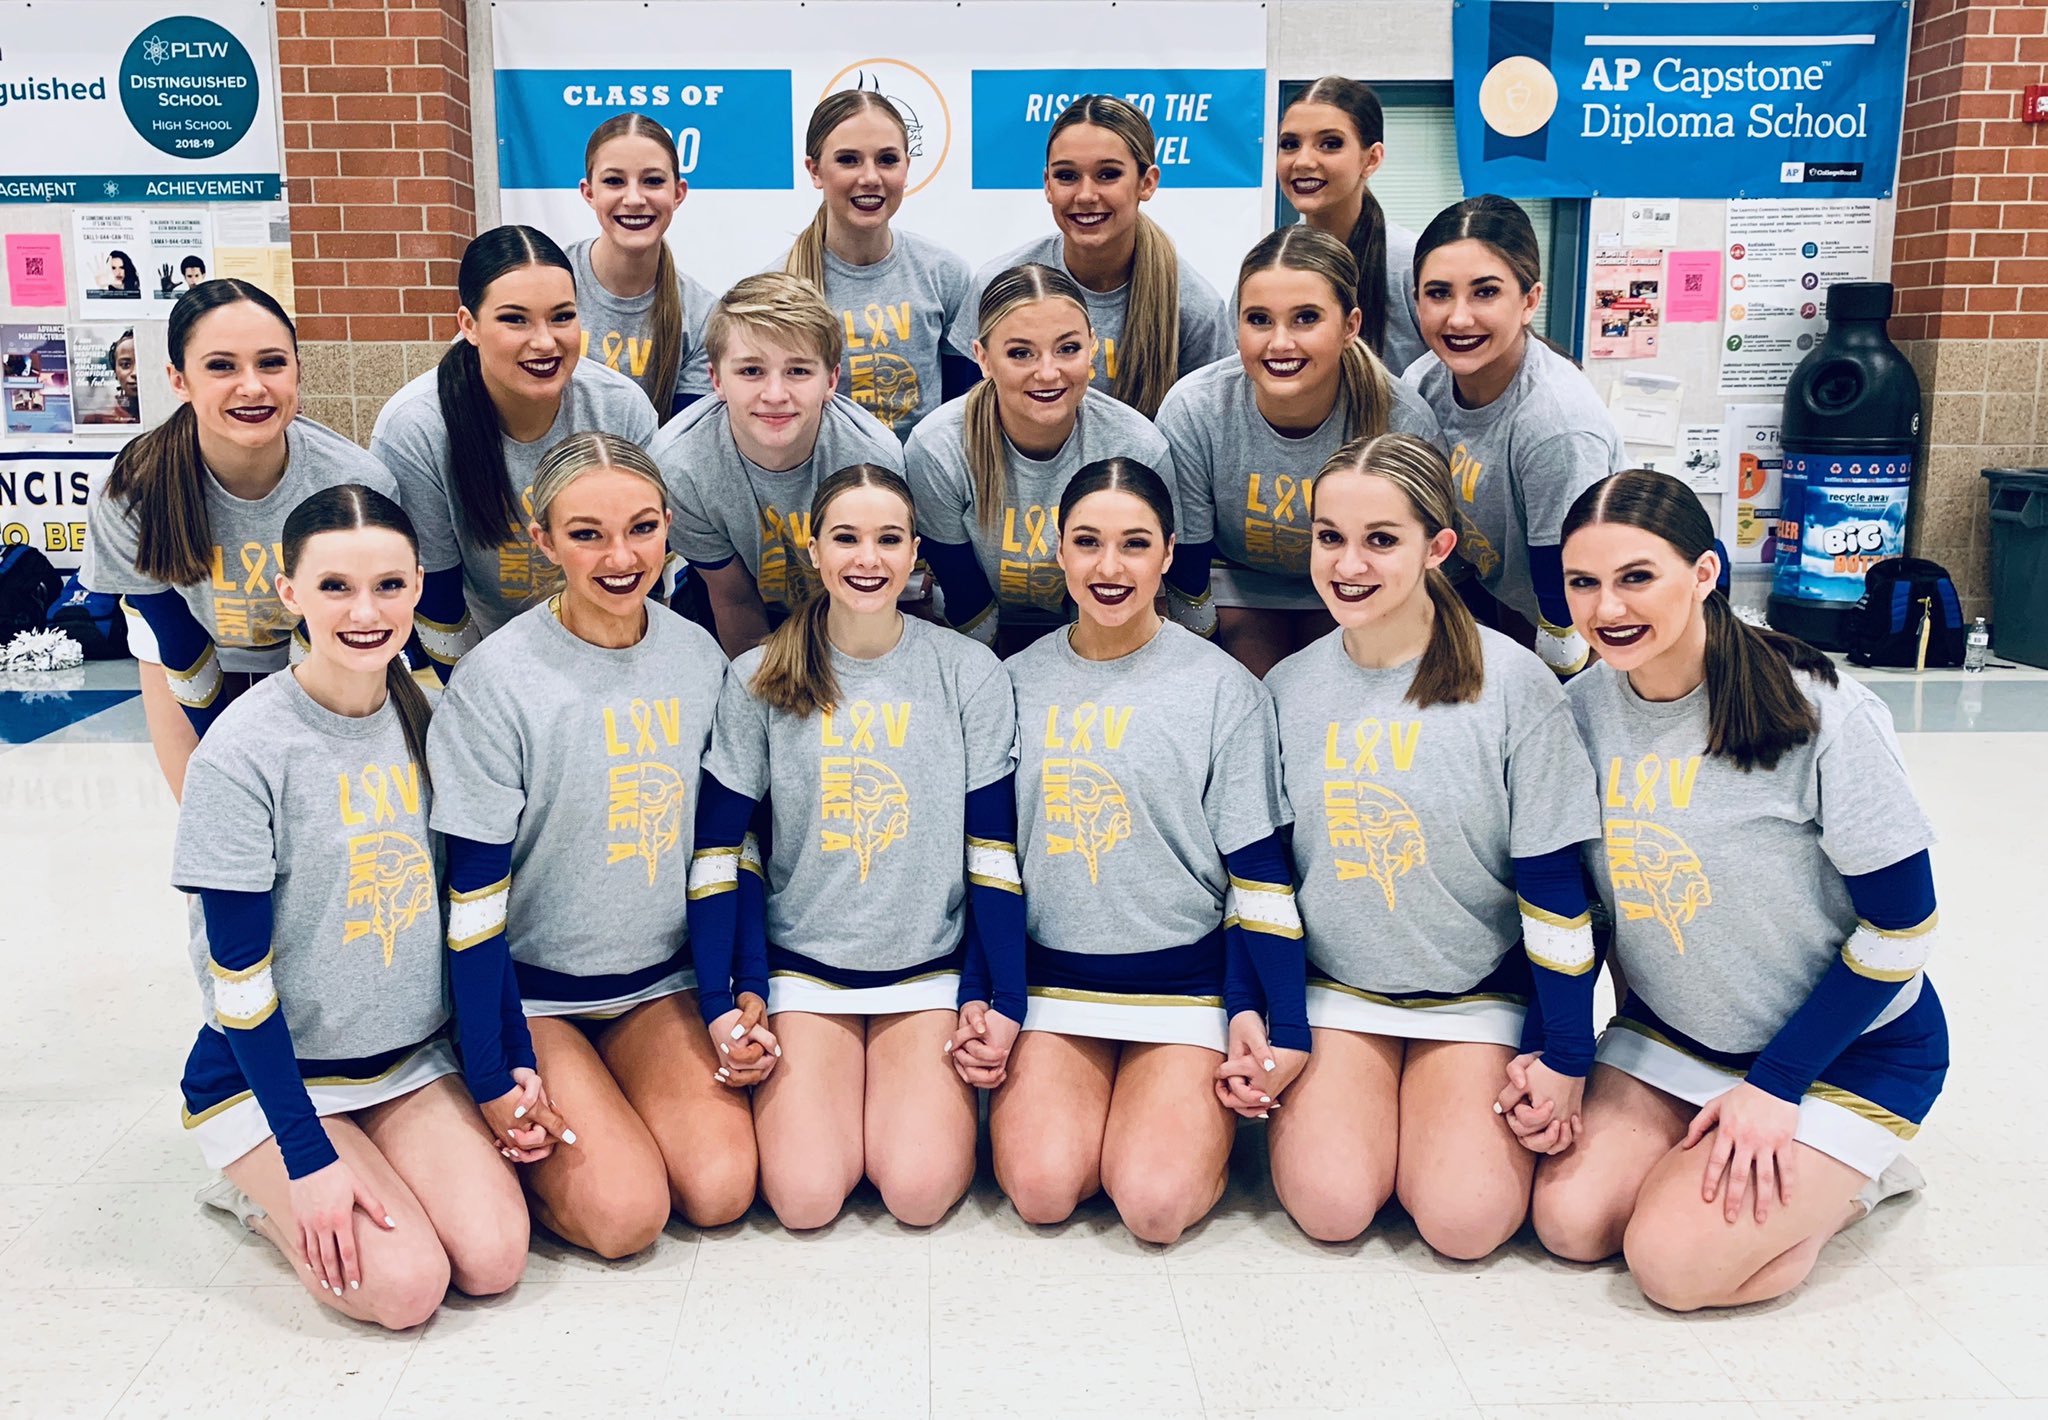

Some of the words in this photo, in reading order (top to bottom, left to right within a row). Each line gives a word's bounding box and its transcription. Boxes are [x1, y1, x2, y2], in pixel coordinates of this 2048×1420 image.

[171, 42, 229, 58] PLTW
[130, 75, 247, 90] DISTINGUISHED
[1581, 57, 1642, 92] AP
[158, 93, 222, 107] SCHOOL
[563, 85, 671, 106] CLASS
[681, 85, 724, 106] OF
[1165, 94, 1213, 122] THE
[152, 120, 182, 131] HIGH
[185, 119, 232, 131] SCHOOL
[1580, 103, 1734, 144] Diploma
[1747, 102, 1867, 139] School
[175, 139, 215, 149] 2018-19
[1786, 168, 1799, 177] AP
[146, 181, 264, 196] ACHIEVEMENT
[849, 353, 876, 404] LIKE
[1829, 493, 1865, 503] recycle
[1868, 494, 1890, 503] away
[0, 522, 29, 547] O
[1823, 524, 1884, 556] BiG
[608, 763, 639, 832] LIKE
[820, 757, 852, 820] LIKE
[1042, 758, 1073, 824] LIKE
[1323, 780, 1364, 849] LIKE
[821, 830, 852, 852] A
[1046, 833, 1075, 856] A
[607, 842, 637, 865] A
[1606, 818, 1647, 890] LIKE
[346, 834, 377, 910] LIKE
[1334, 859, 1369, 882] A
[1619, 900, 1655, 921] A
[342, 919, 370, 946] A
